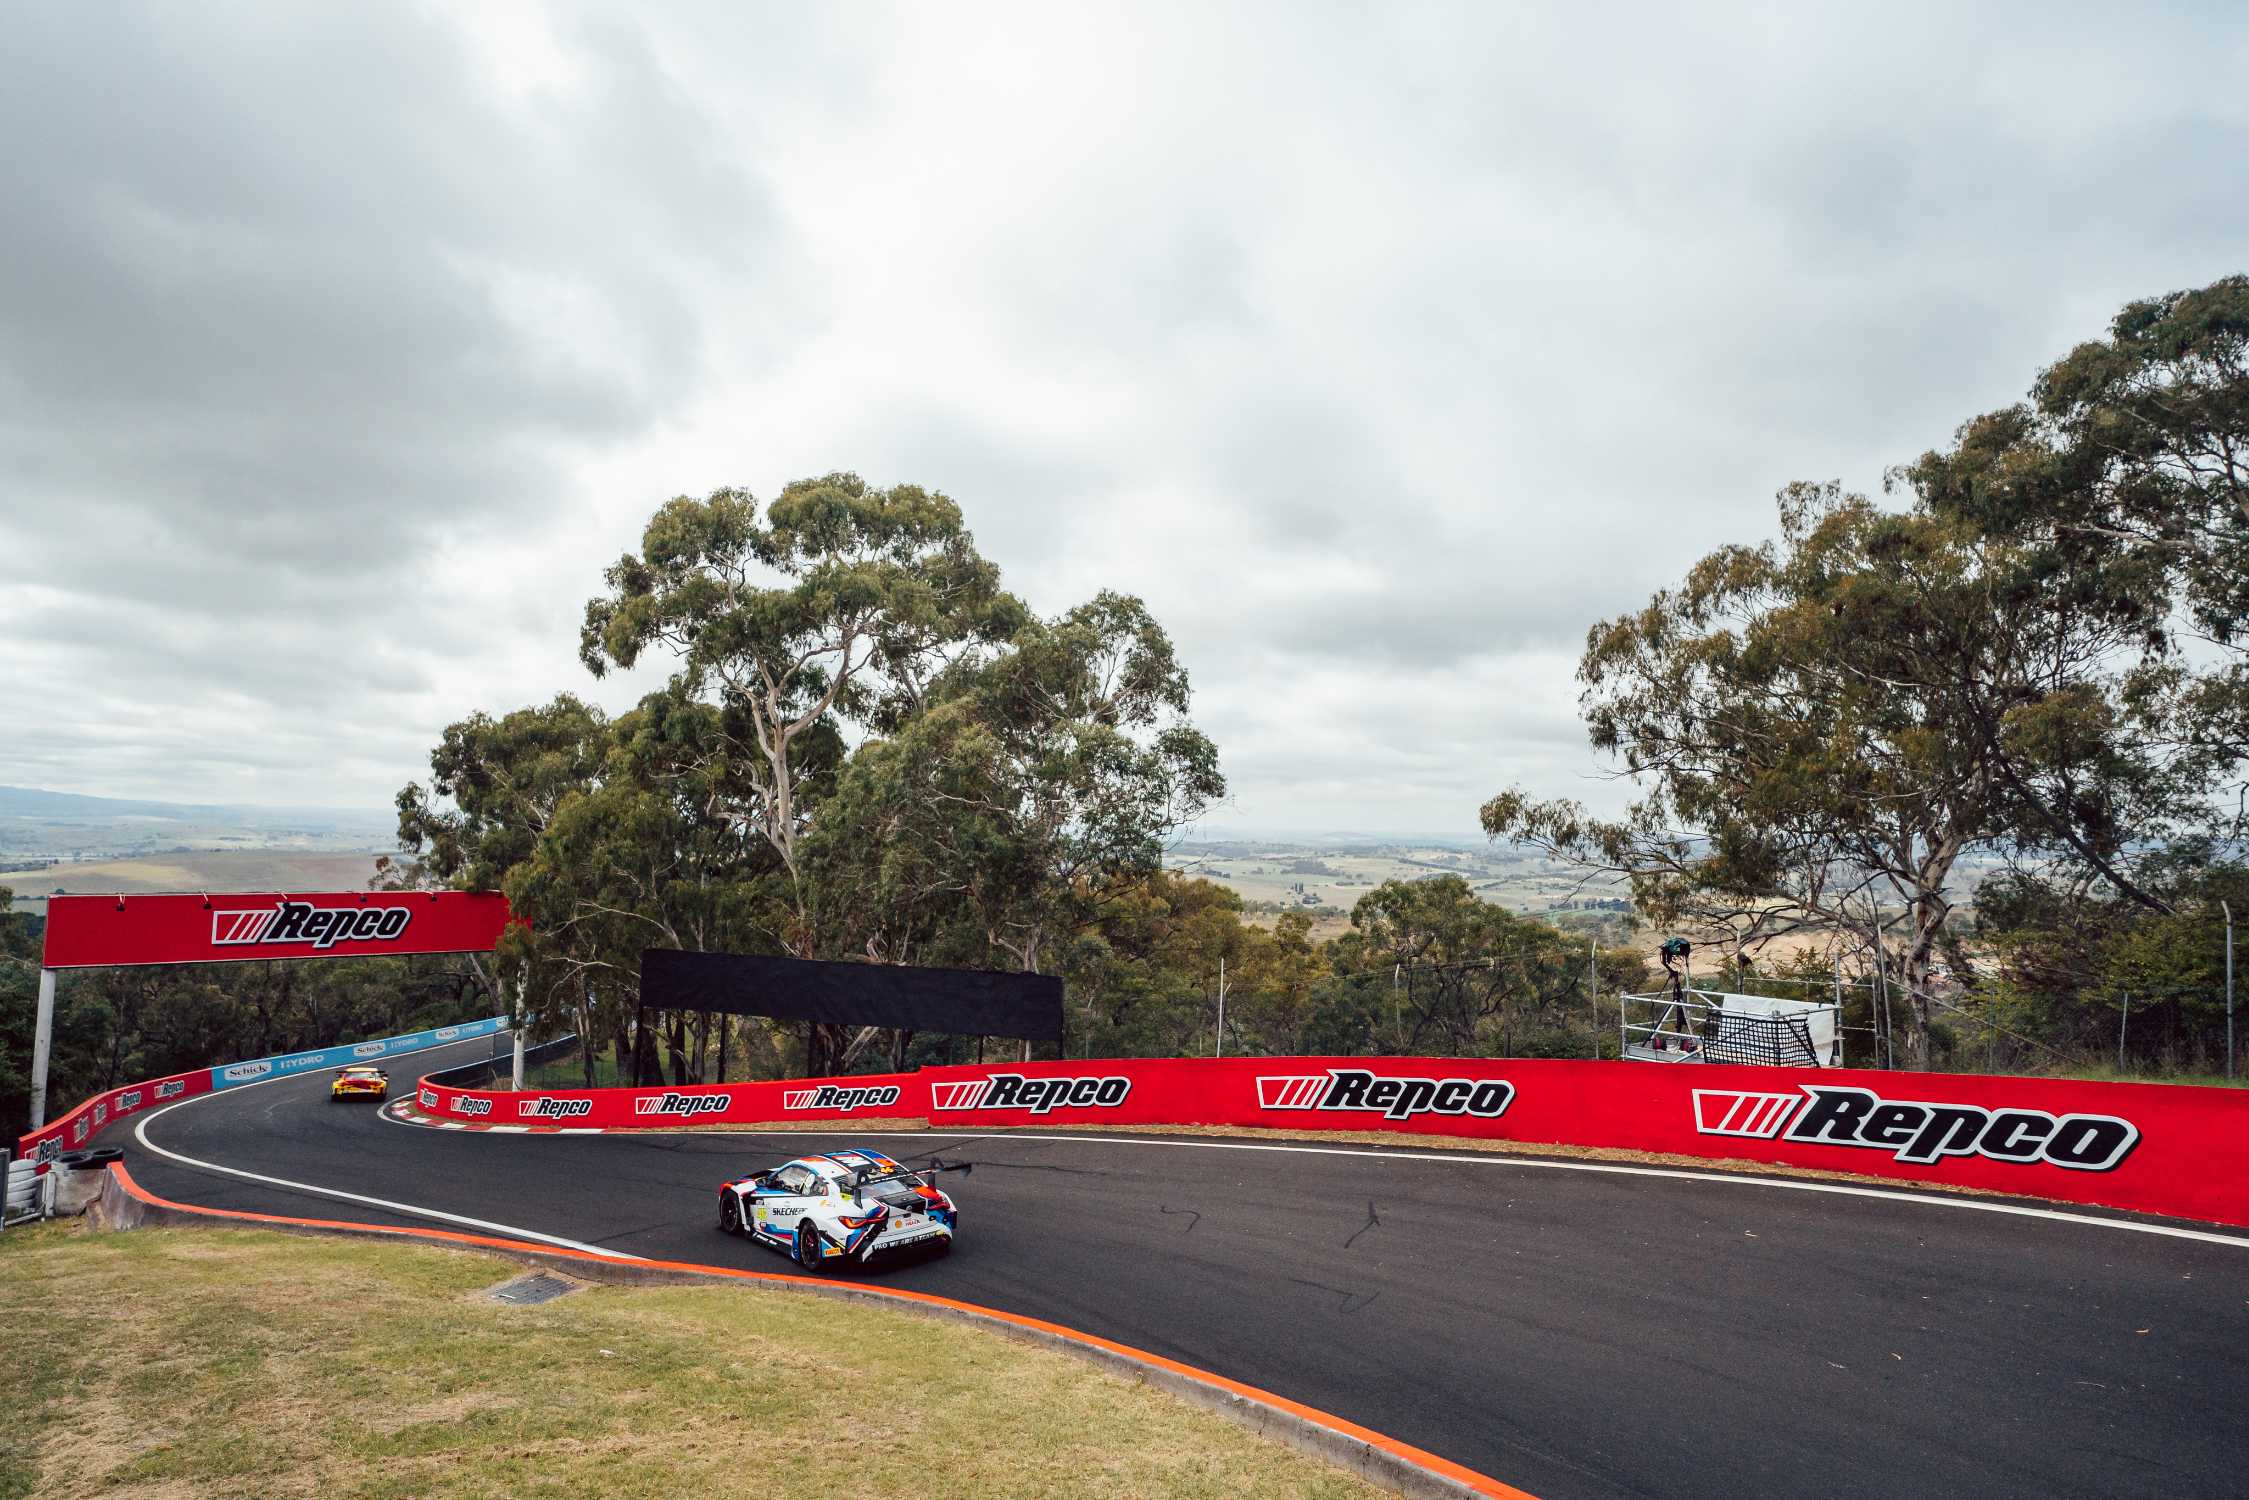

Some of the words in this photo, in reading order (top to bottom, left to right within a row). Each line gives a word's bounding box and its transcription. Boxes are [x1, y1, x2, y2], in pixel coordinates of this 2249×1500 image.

[261, 902, 411, 948] Repco
[230, 1065, 269, 1077] Schick
[460, 1095, 492, 1116] Repco
[658, 1092, 732, 1117] Repco
[810, 1085, 901, 1111] Repco
[978, 1073, 1131, 1114] Repco
[1317, 1069, 1516, 1119] Repco
[536, 1097, 592, 1119] Repco
[1783, 1084, 2141, 1171] Repco
